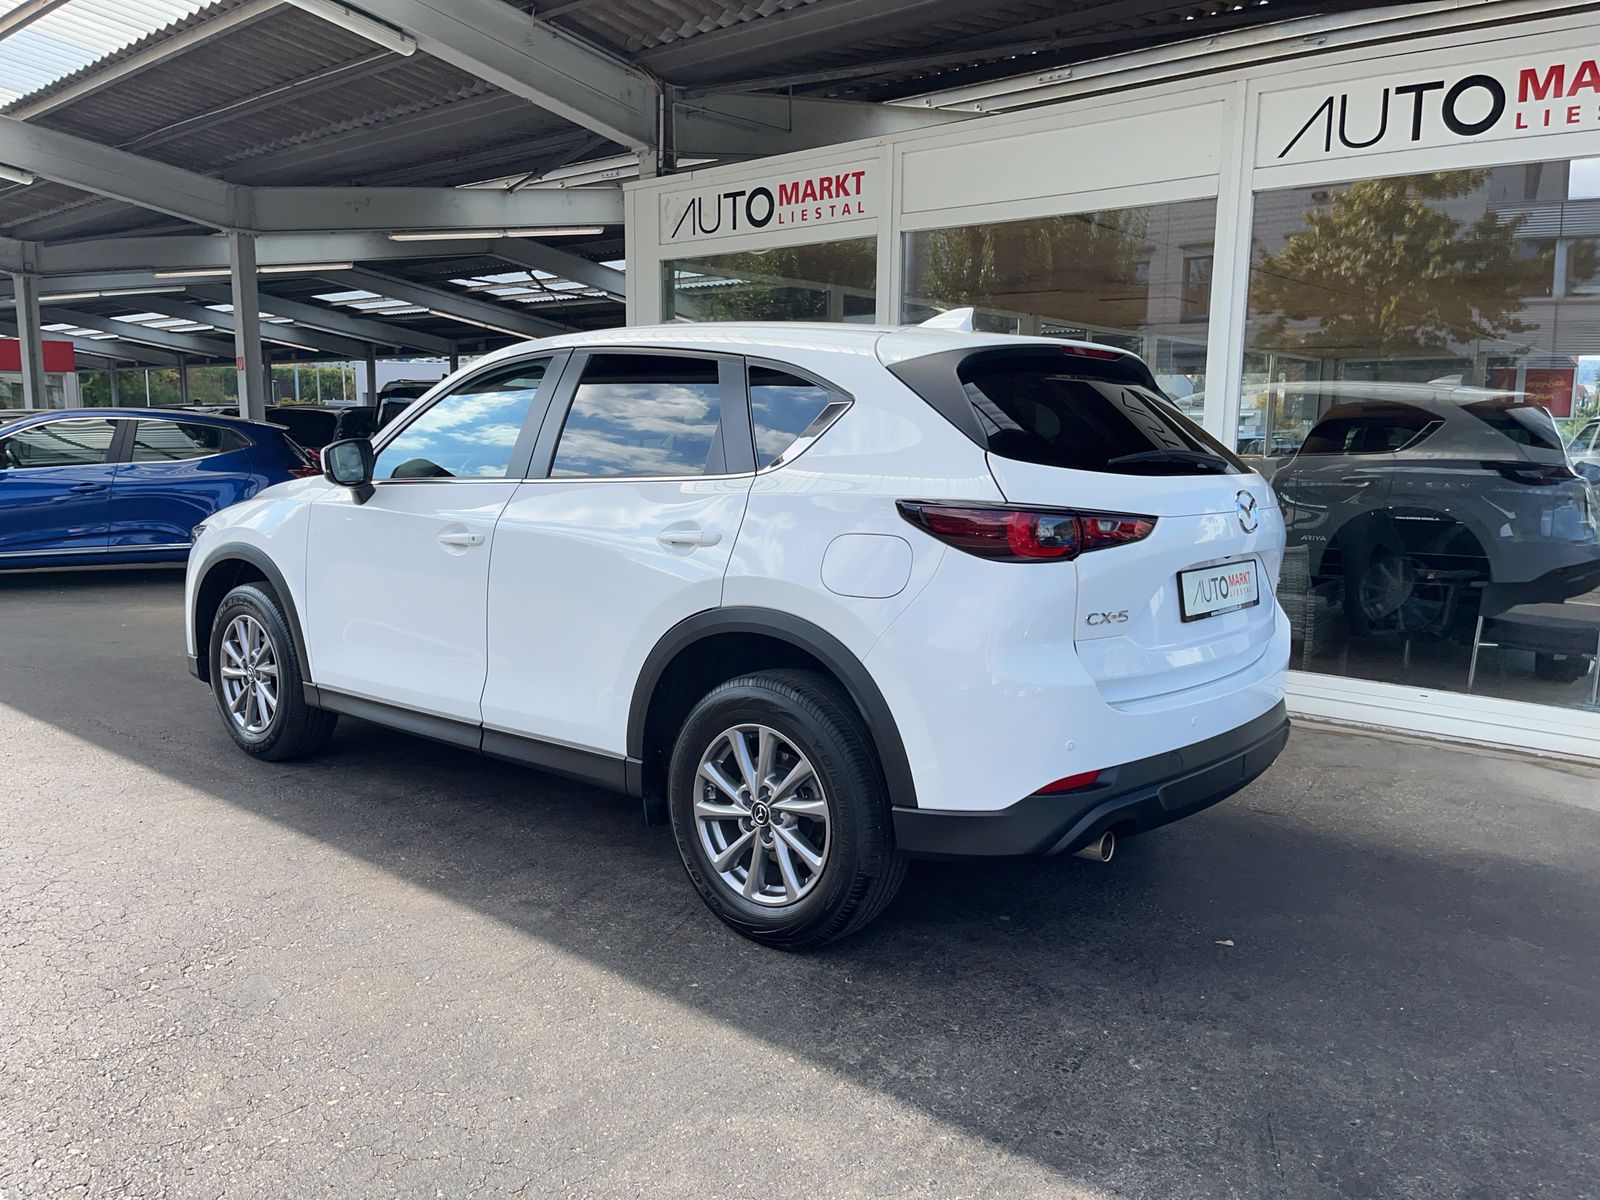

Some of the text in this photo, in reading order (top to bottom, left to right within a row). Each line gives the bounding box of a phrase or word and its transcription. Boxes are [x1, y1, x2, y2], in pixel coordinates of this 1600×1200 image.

[1277, 74, 1506, 158] AUTO
[1515, 104, 1600, 130] LIE
[671, 170, 866, 239] AUTO MARKT
[778, 201, 865, 225] LIESTAL
[1192, 571, 1251, 607] AUTO MARKT
[1085, 609, 1129, 626] CX-5
